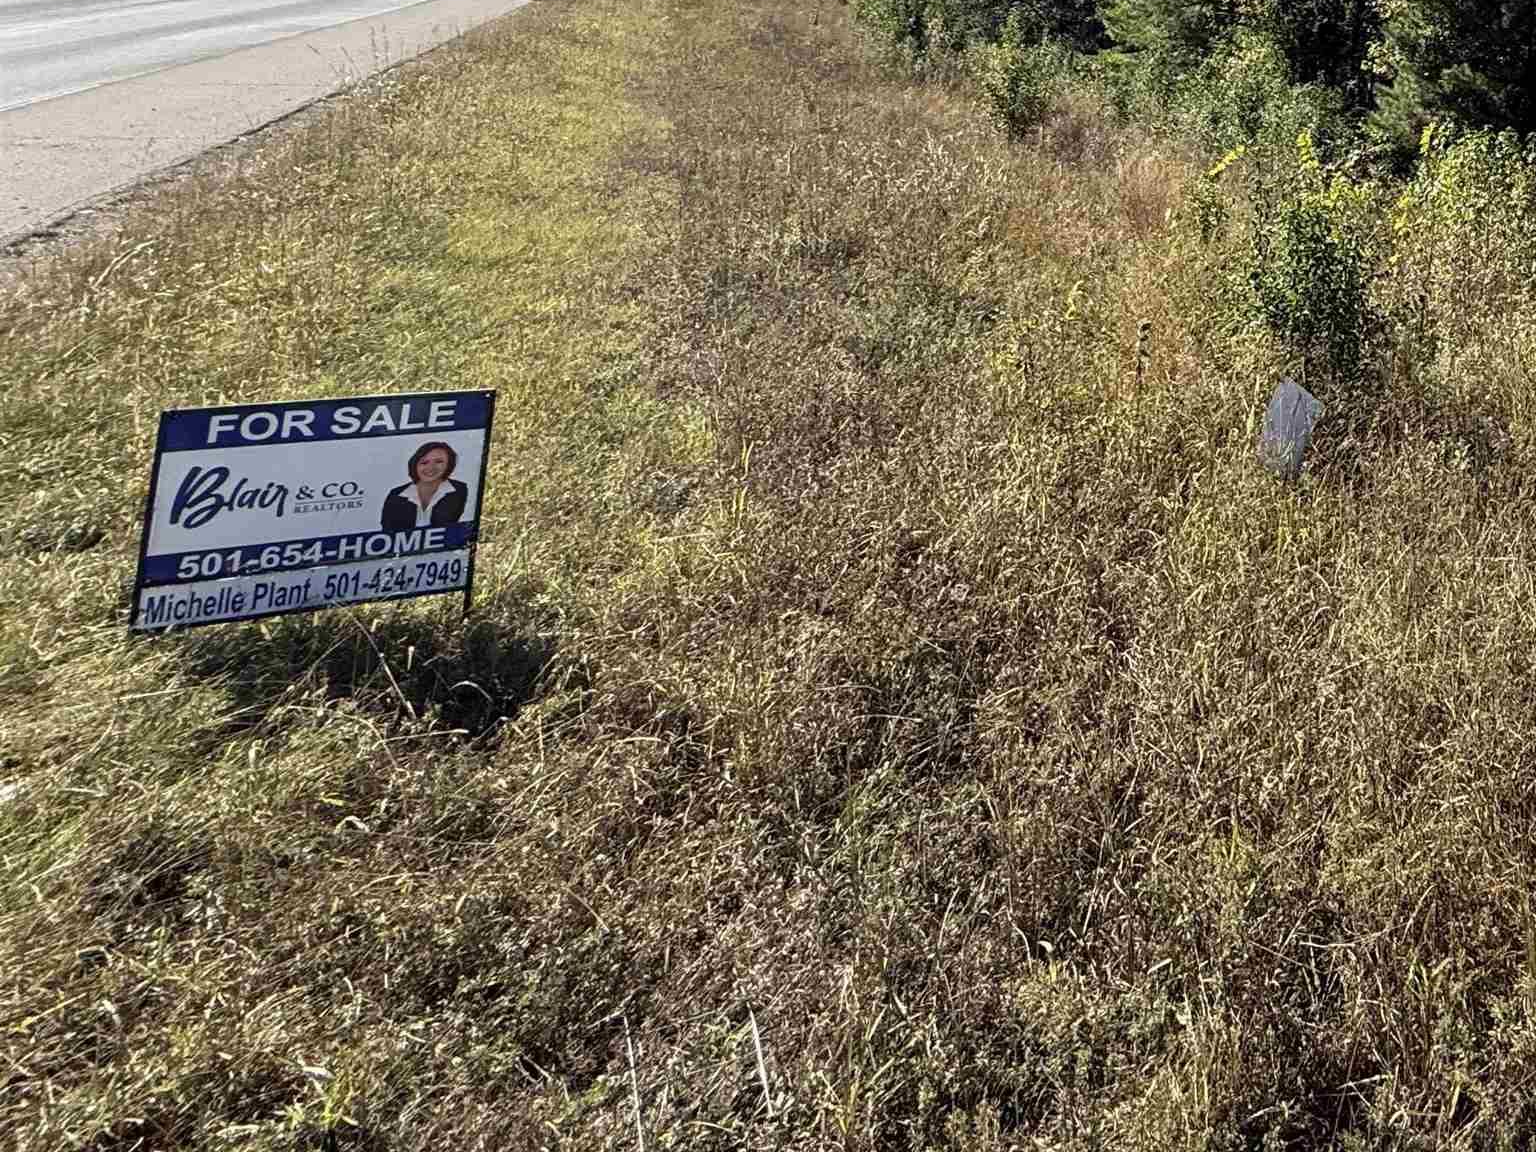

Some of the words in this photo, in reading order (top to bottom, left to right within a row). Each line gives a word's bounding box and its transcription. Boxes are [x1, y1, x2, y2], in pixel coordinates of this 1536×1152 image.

[206, 409, 315, 444] FOR
[329, 399, 458, 434] SALE
[169, 465, 288, 529] Blair
[295, 485, 315, 500] &
[322, 481, 365, 499] CO.
[294, 500, 363, 514] REALTORS
[176, 527, 446, 579] 501-654-HOME
[144, 588, 245, 625] Michelle
[247, 576, 312, 611] Plant
[323, 559, 462, 601] 501-424-7949
